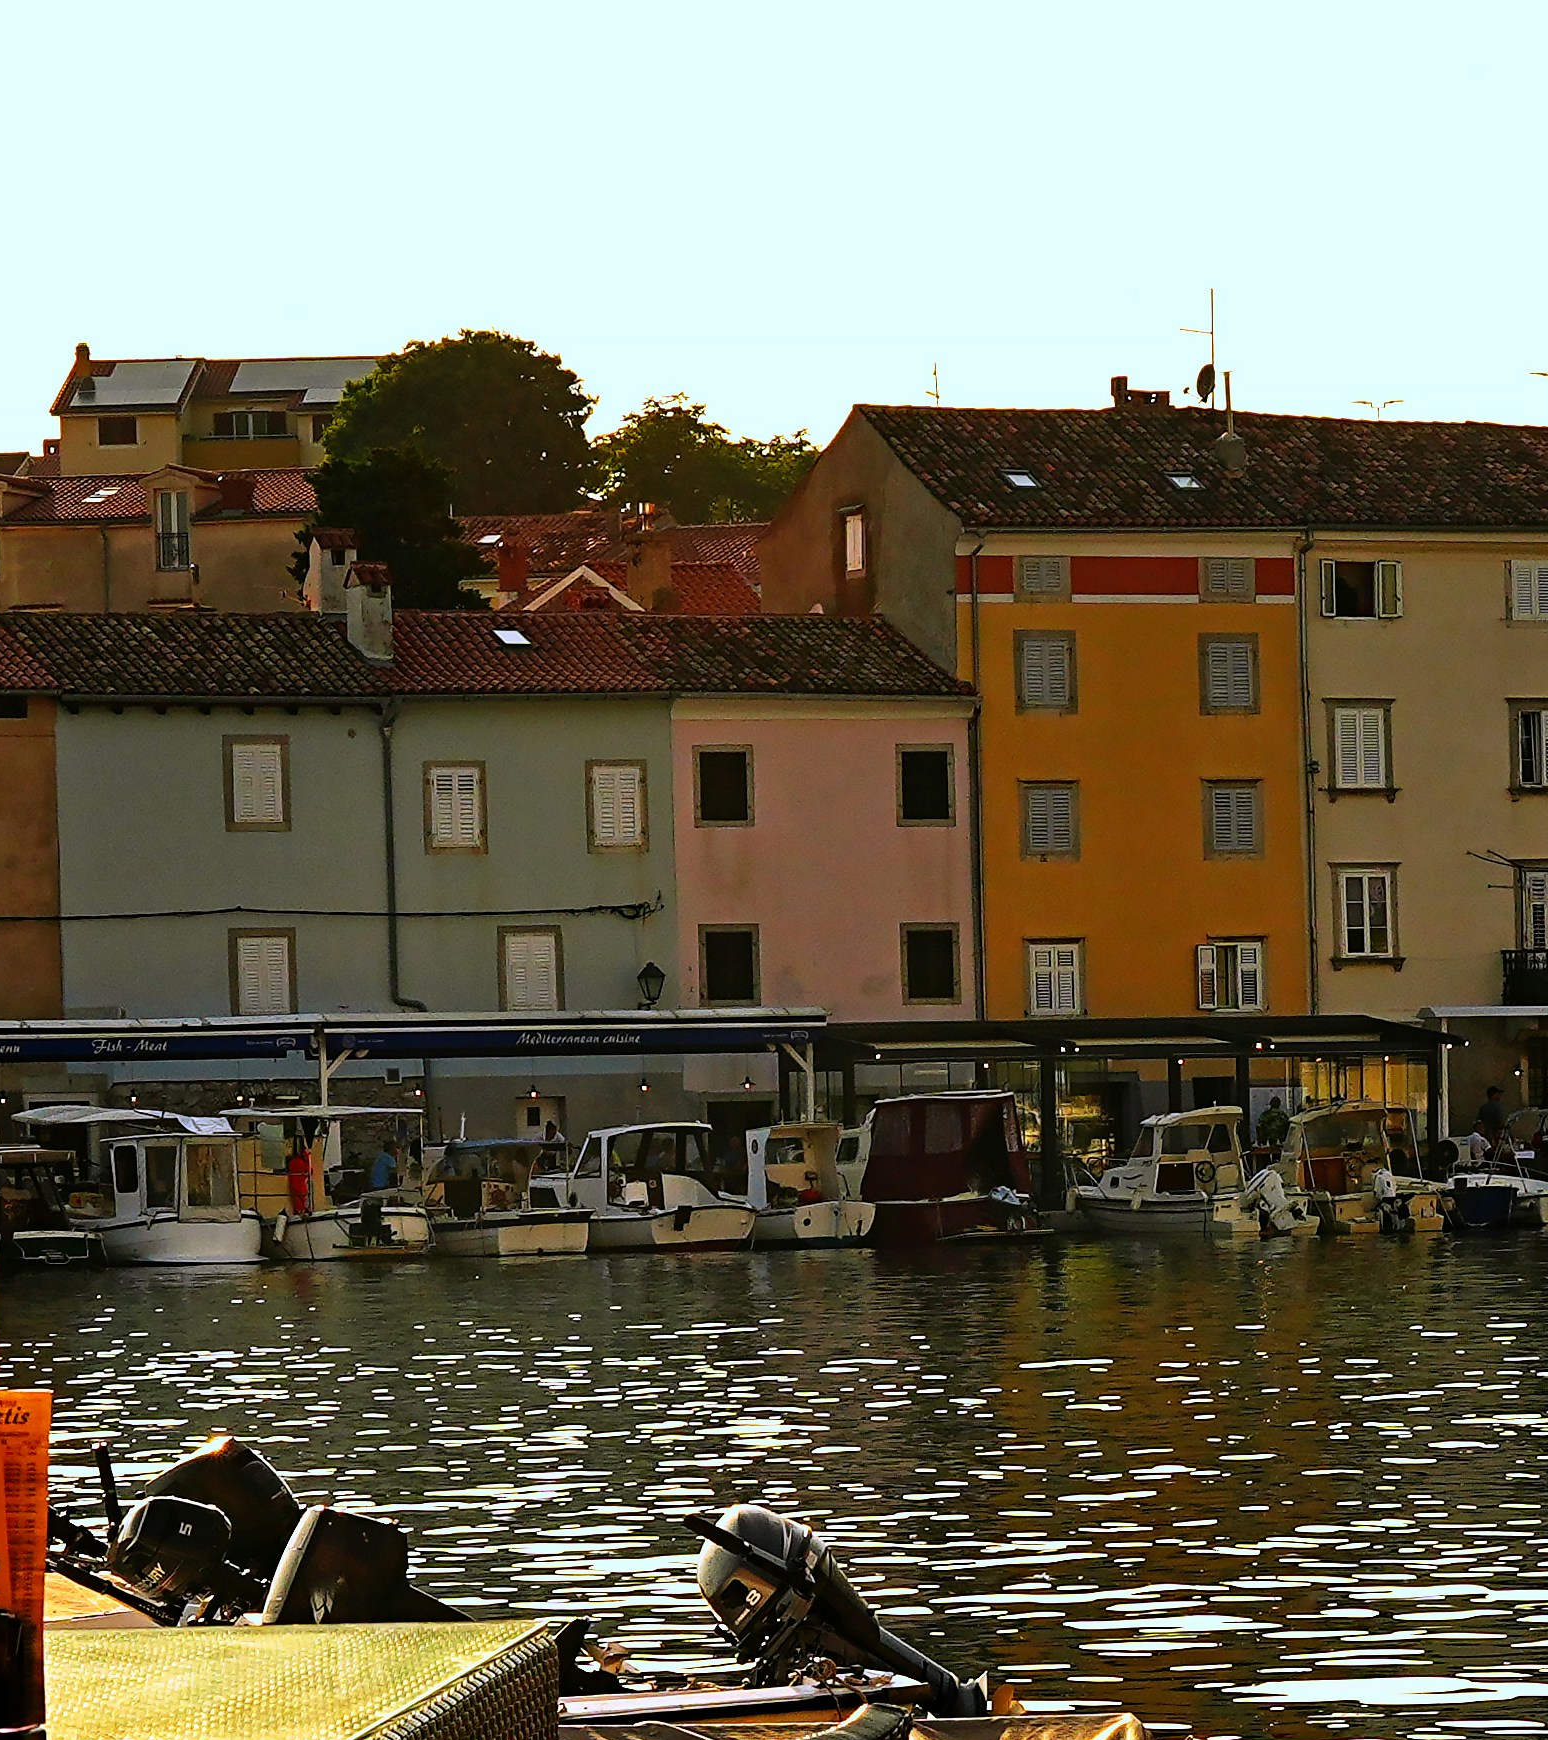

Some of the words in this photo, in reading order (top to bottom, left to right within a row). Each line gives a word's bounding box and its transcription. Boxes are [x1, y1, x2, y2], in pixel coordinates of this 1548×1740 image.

[516, 1031, 599, 1046] Mediterranean
[602, 1033, 641, 1044] cuisine
[92, 1039, 122, 1054] Fish
[134, 1039, 167, 1052] Meat
[179, 1522, 192, 1536] 5
[746, 1589, 762, 1606] 8
